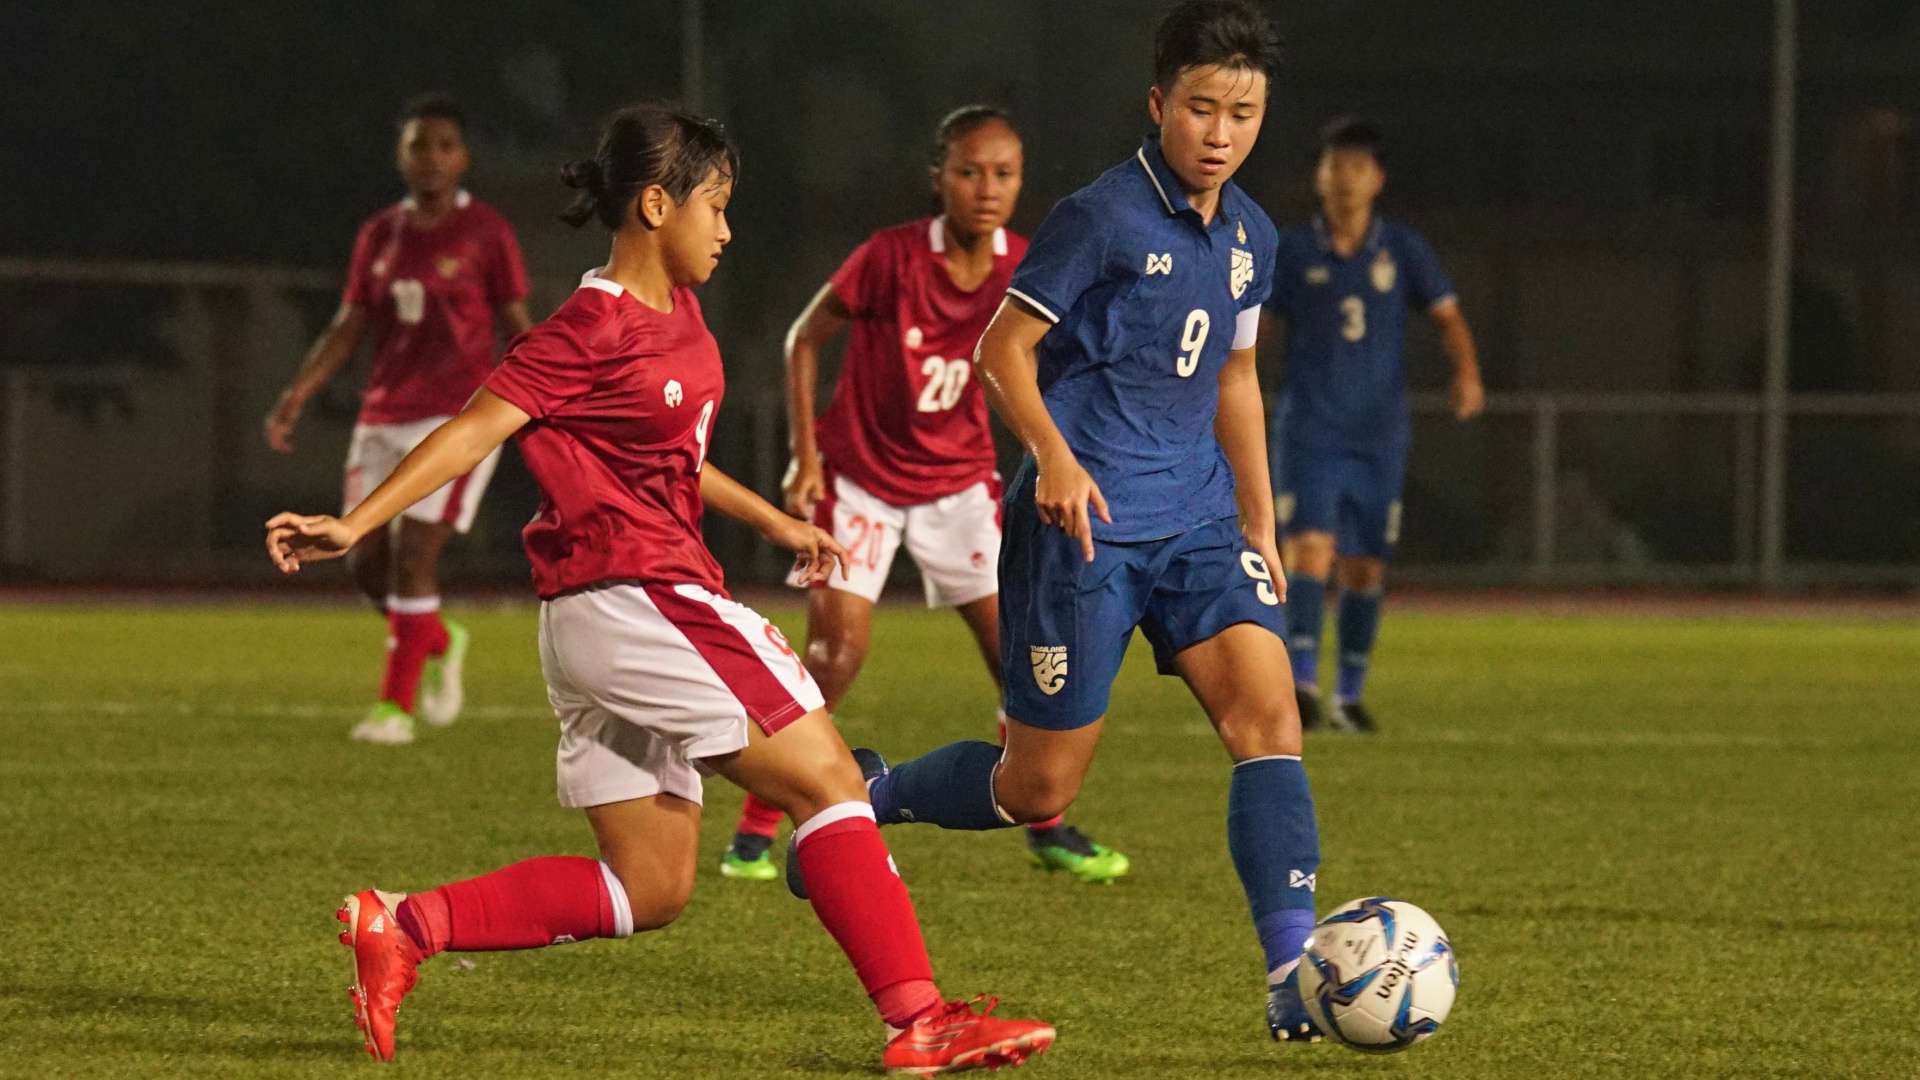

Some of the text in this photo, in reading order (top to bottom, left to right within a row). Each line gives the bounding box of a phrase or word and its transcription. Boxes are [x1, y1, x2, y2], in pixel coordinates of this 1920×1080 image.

[1177, 308, 1210, 378] 9
[1341, 296, 1366, 342] 3
[917, 355, 970, 413] 20
[695, 399, 714, 473] 9
[847, 514, 884, 572] 20
[1241, 551, 1279, 606] 9
[1375, 930, 1419, 1000] molten
